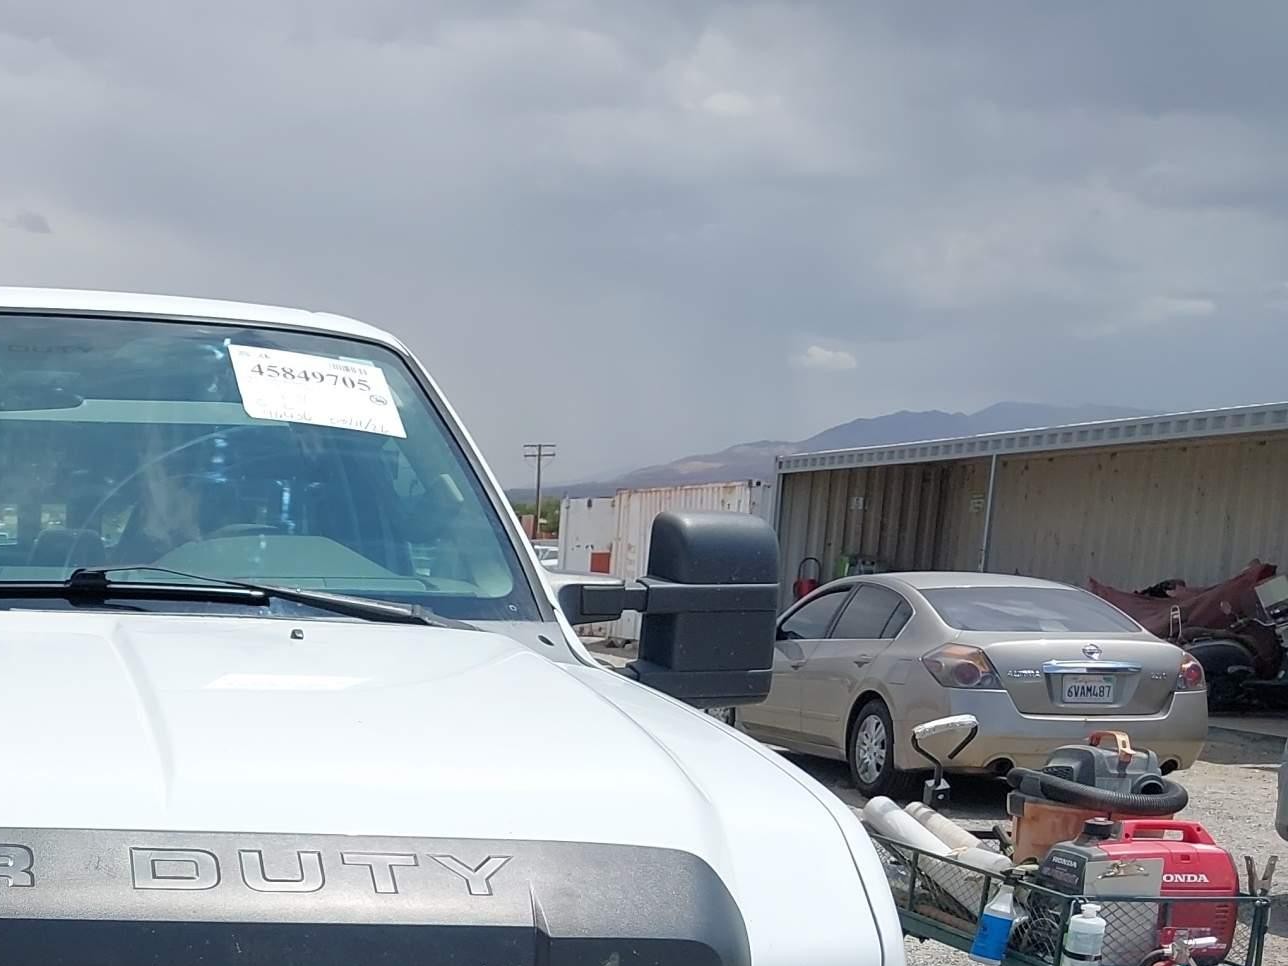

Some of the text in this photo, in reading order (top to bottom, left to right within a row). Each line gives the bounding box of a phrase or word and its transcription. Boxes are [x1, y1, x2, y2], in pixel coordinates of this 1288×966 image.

[251, 363, 372, 392] 45849705
[1067, 685, 1112, 698] 6VAM487
[129, 846, 513, 896] DUTY
[1162, 873, 1210, 883] ONDA
